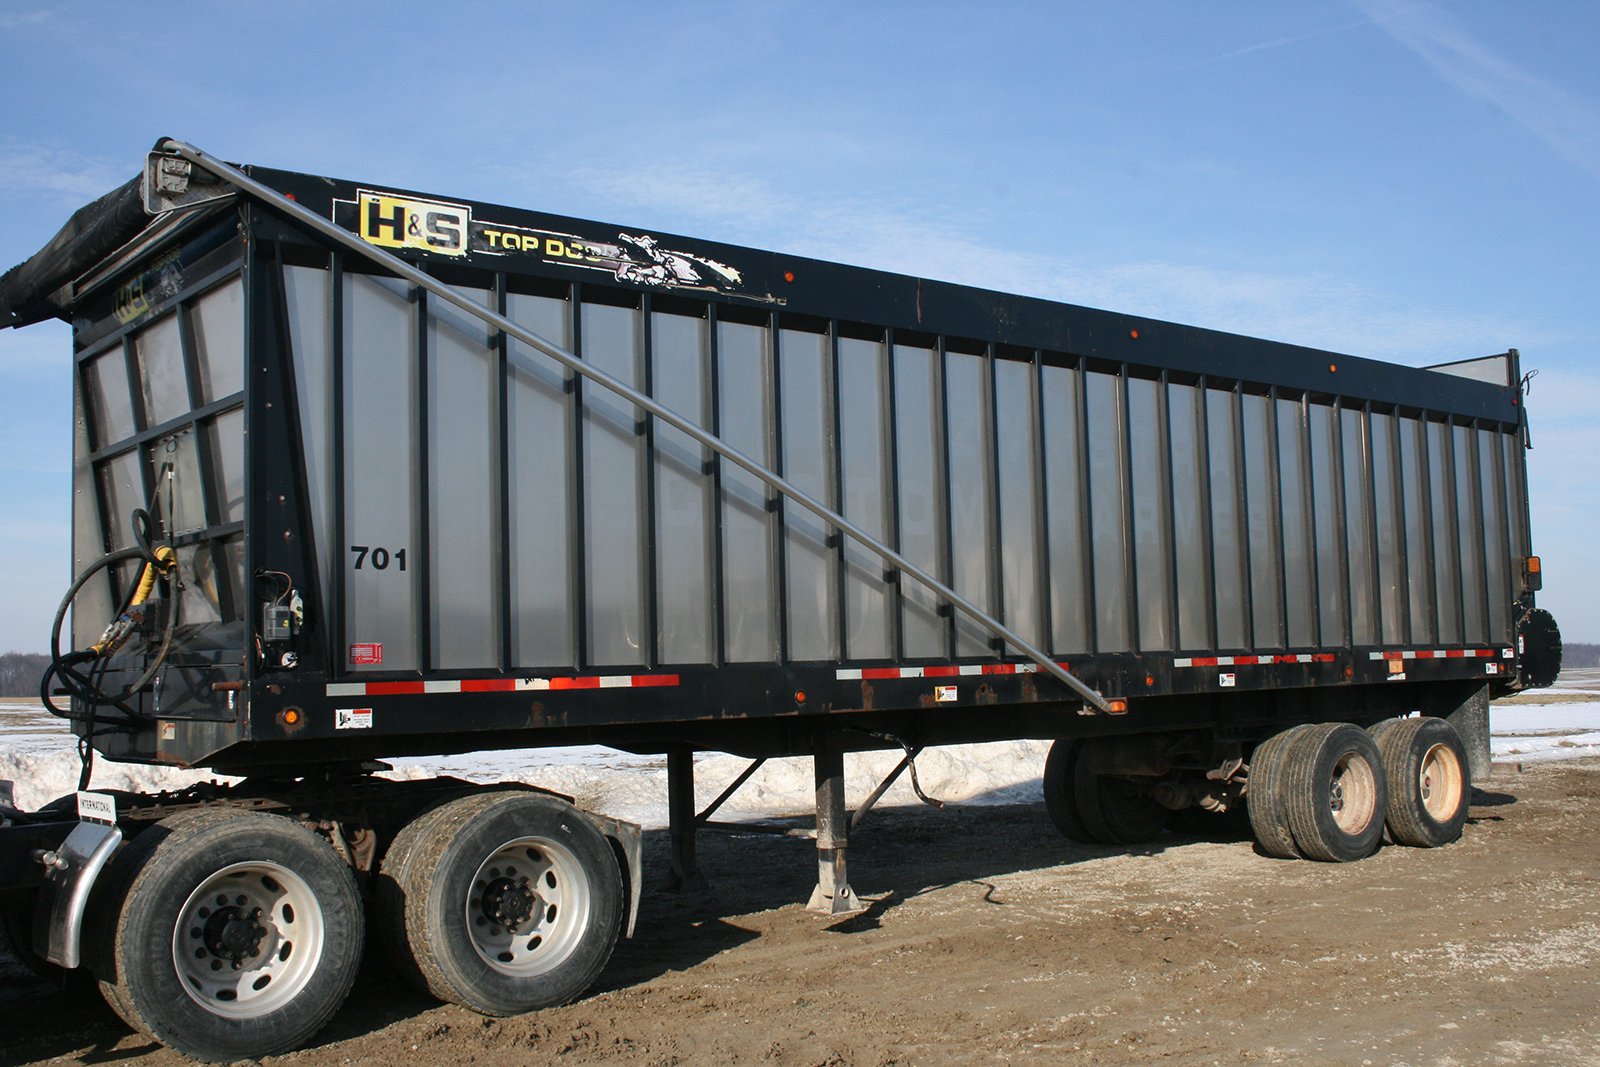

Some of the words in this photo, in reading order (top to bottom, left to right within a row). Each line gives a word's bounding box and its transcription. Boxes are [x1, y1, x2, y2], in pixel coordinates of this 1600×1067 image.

[368, 202, 461, 250] H&S
[484, 230, 539, 252] TOP
[350, 546, 407, 572] 701
